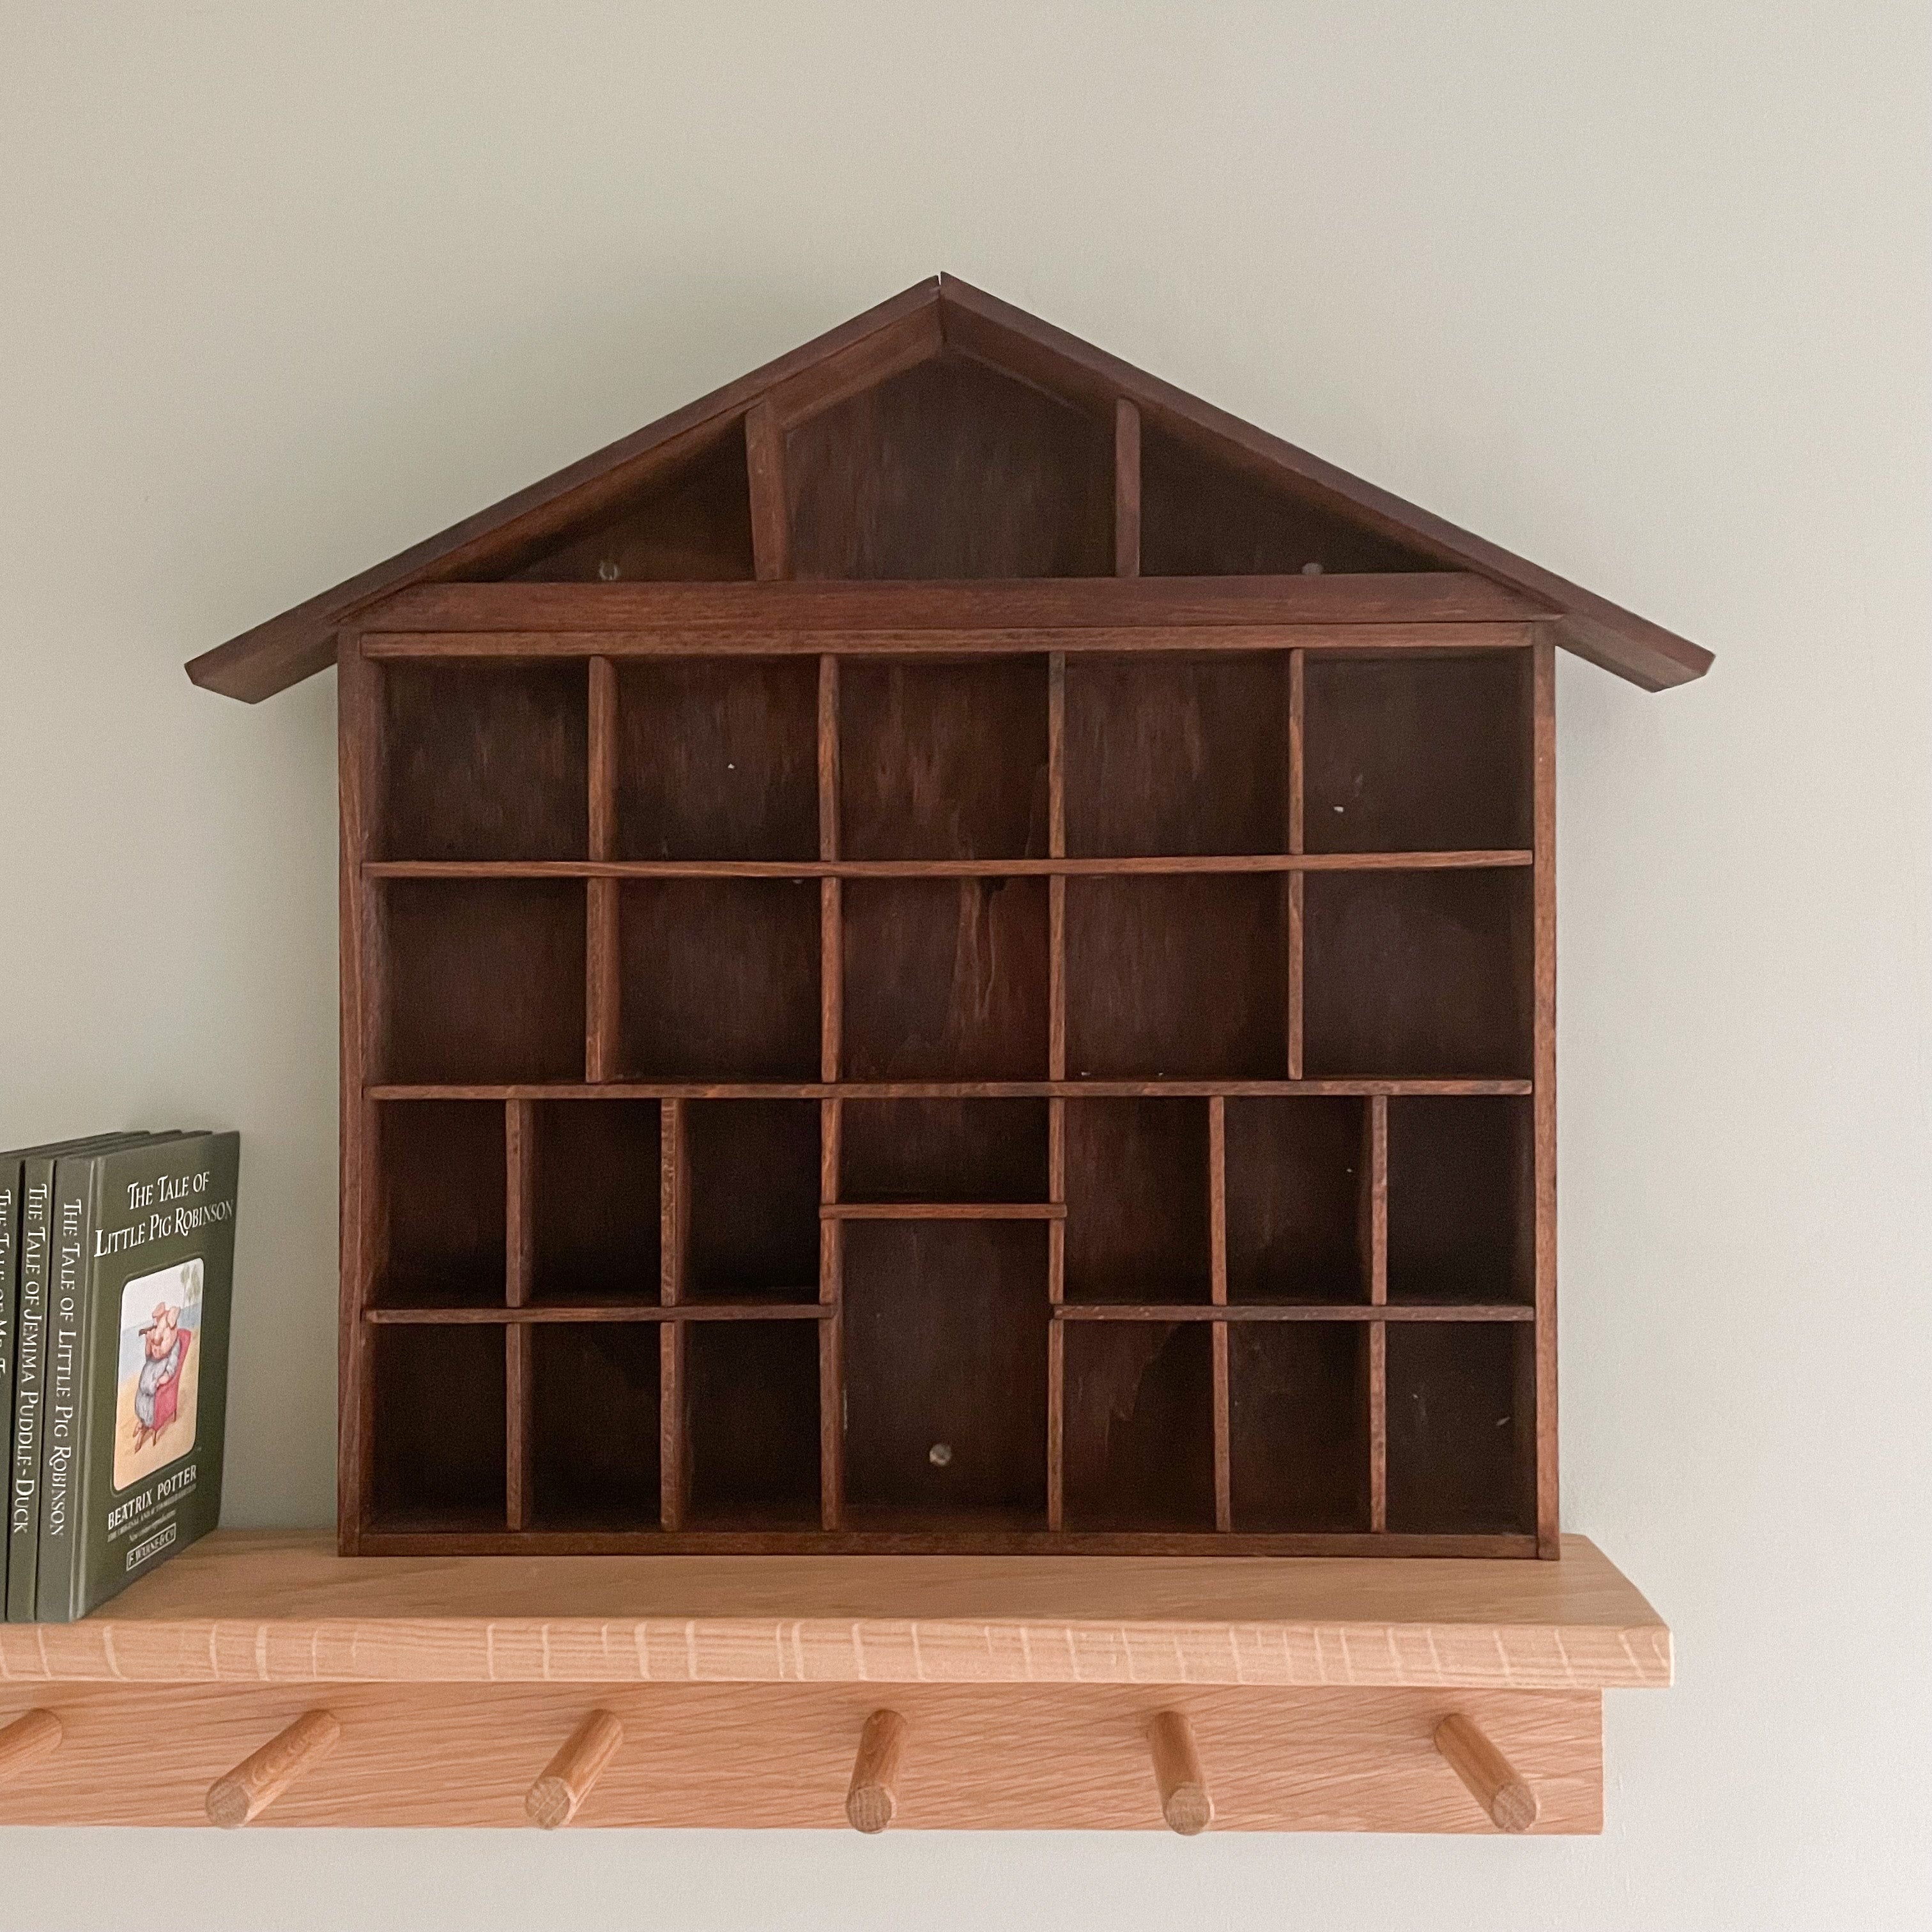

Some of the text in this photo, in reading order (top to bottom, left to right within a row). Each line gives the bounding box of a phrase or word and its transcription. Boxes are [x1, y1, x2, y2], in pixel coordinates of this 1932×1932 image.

[28, 1183, 47, 1220] THE
[127, 1171, 210, 1210] THE TALE OF
[26, 1227, 45, 1274] TALE
[94, 1200, 234, 1257] LITTLE PIG ROBINSON
[25, 1281, 40, 1305] OF
[21, 1310, 42, 1383] JEMIMA
[49, 1199, 82, 1536] THE TALE OF LITTLE PIG ROBINSON
[108, 1489, 153, 1531] BEATRIX
[157, 1464, 197, 1501] POTTER
